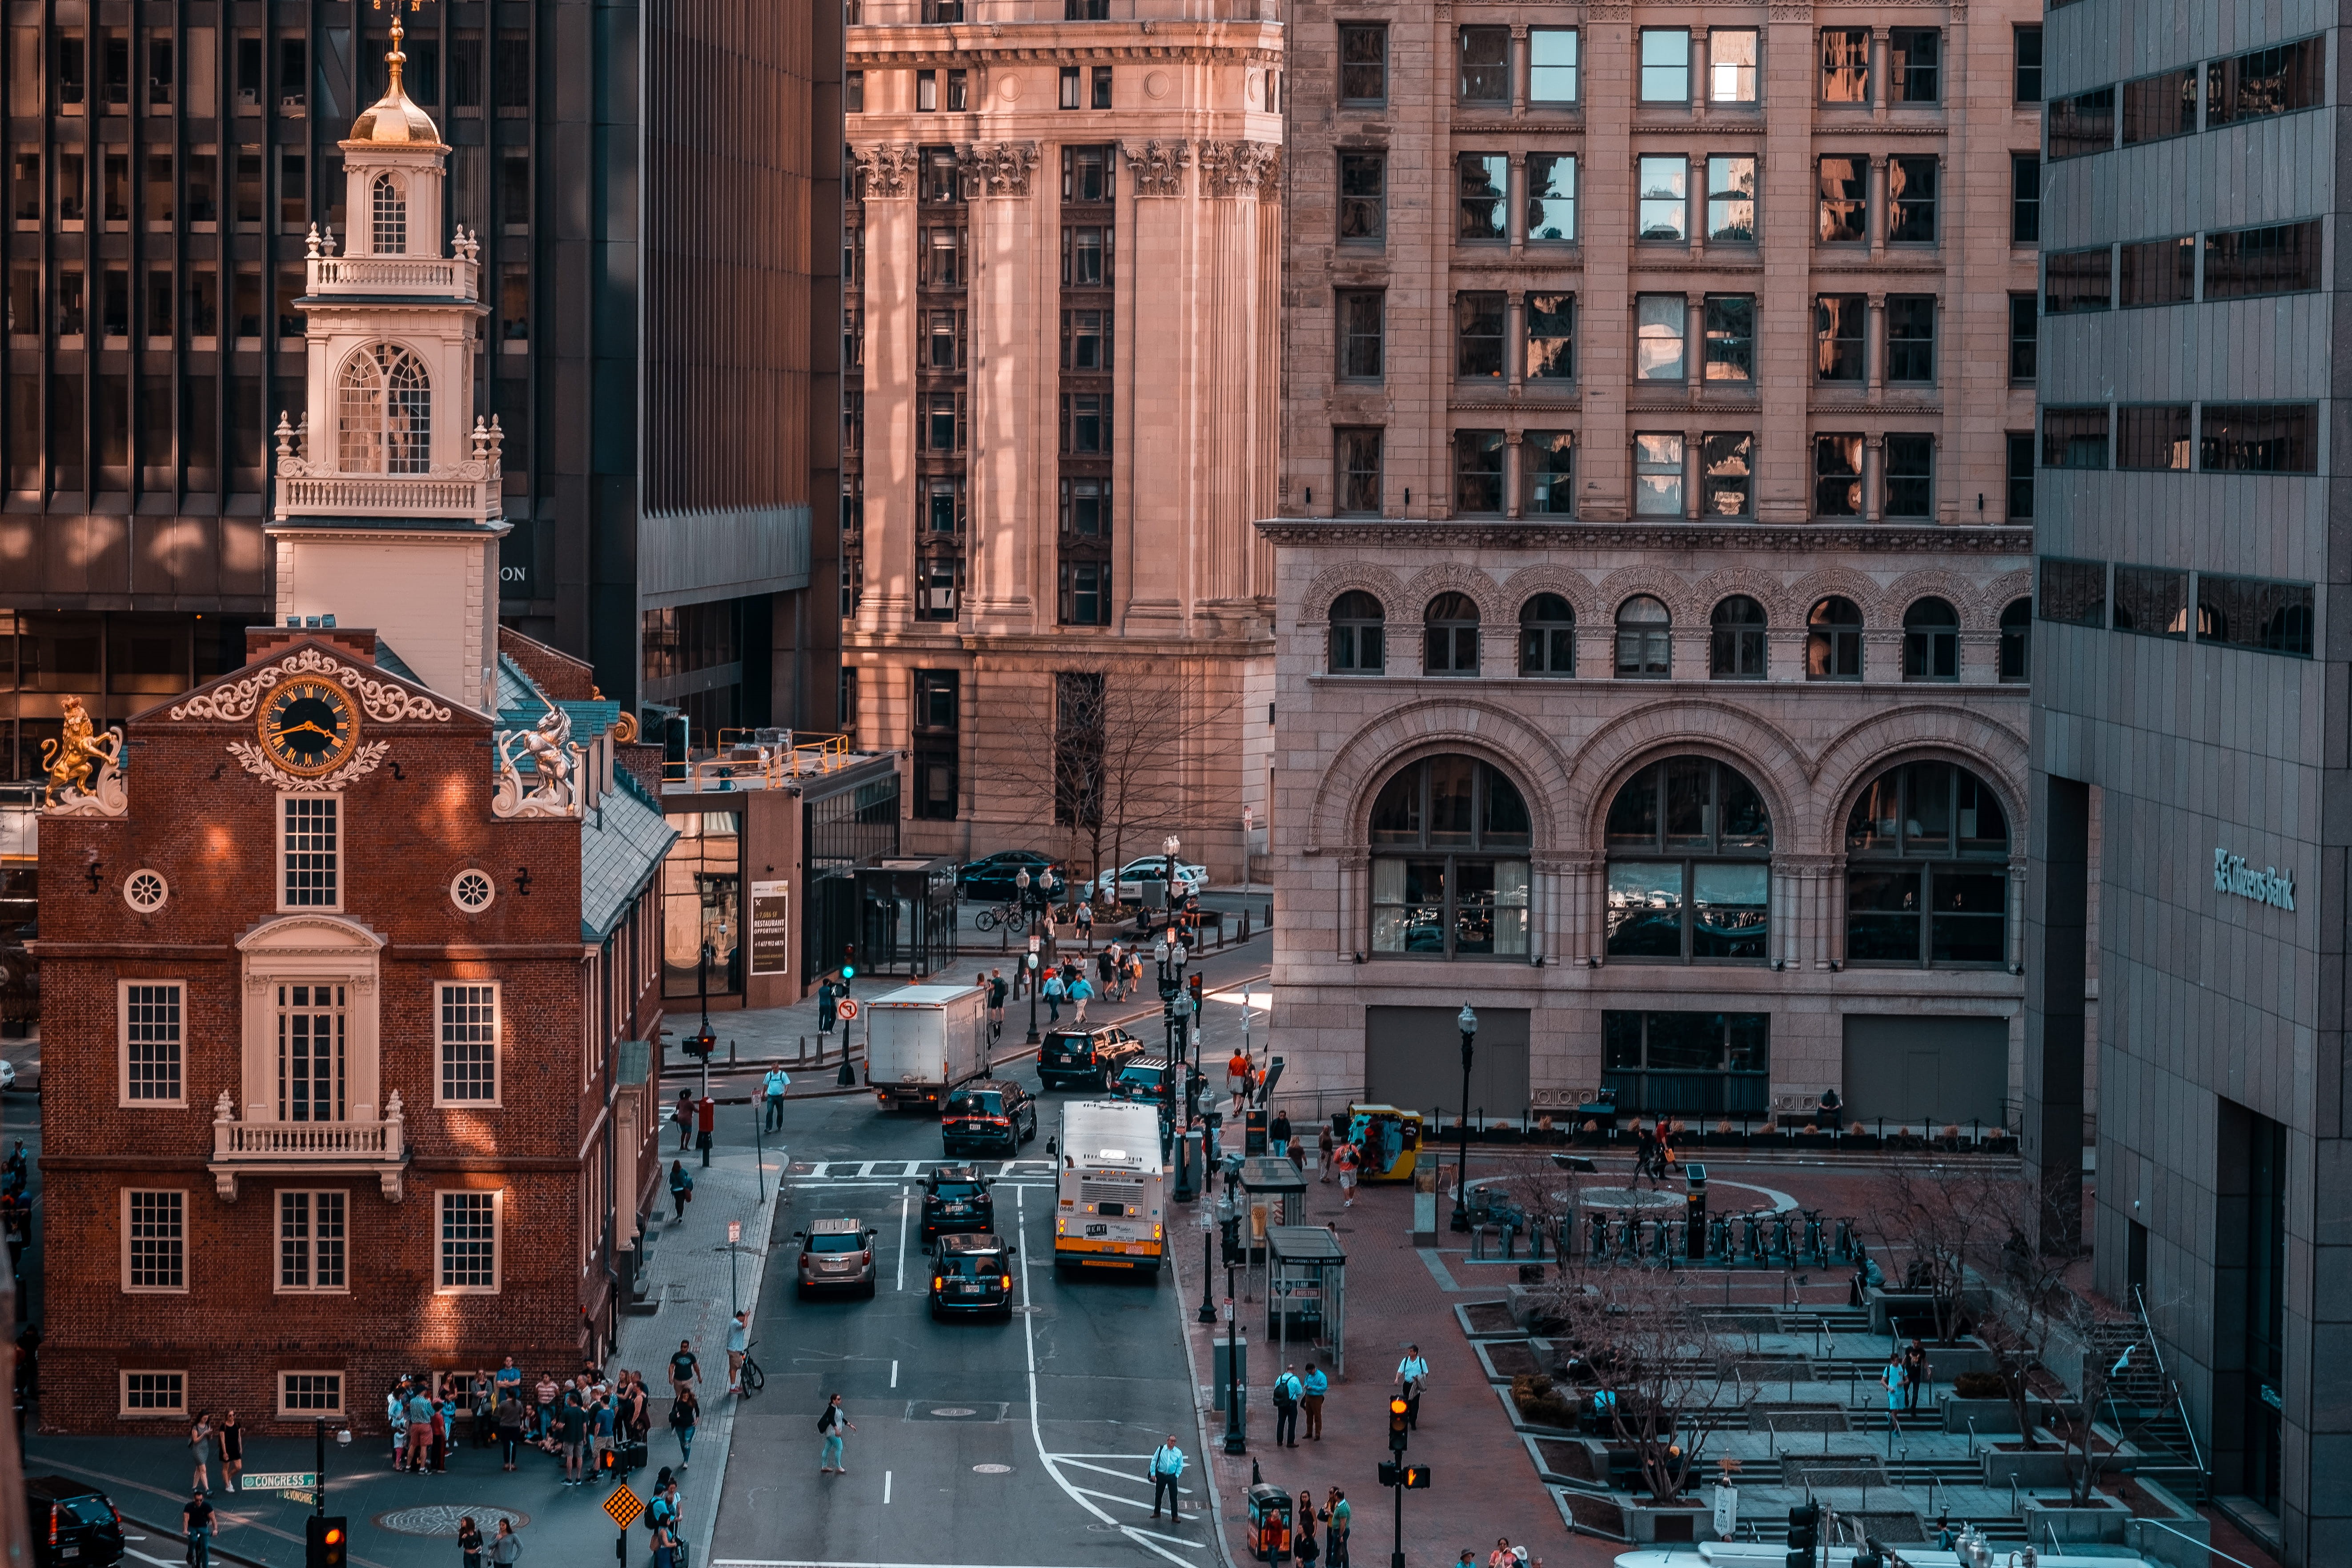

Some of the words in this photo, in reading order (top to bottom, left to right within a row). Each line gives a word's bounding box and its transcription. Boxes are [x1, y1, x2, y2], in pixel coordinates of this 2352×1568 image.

[2227, 855, 2266, 902] Citizens
[2267, 866, 2295, 911] Bank
[754, 919, 784, 928] RESTAURANT
[255, 1475, 304, 1487] CONGRESS
[283, 1489, 313, 1505] DEVONSHIRE
